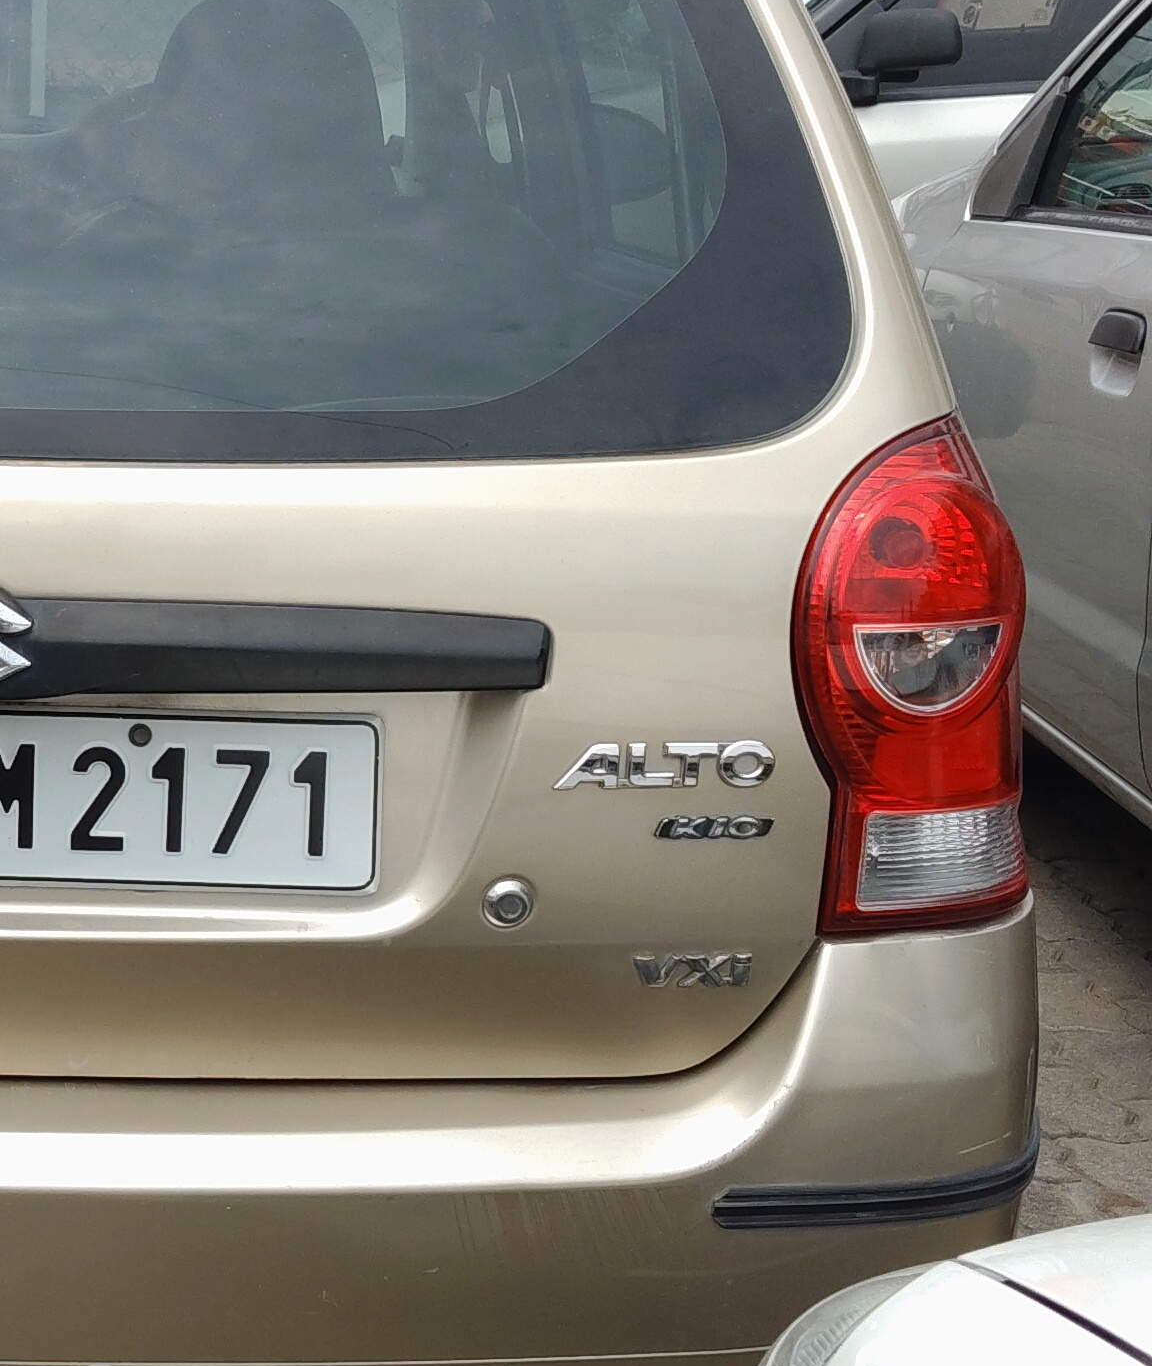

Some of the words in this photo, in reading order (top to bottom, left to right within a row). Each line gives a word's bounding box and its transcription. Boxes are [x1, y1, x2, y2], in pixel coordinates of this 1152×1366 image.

[552, 739, 776, 790] ALTO
[68, 746, 329, 857] 2171
[666, 815, 764, 840] K10
